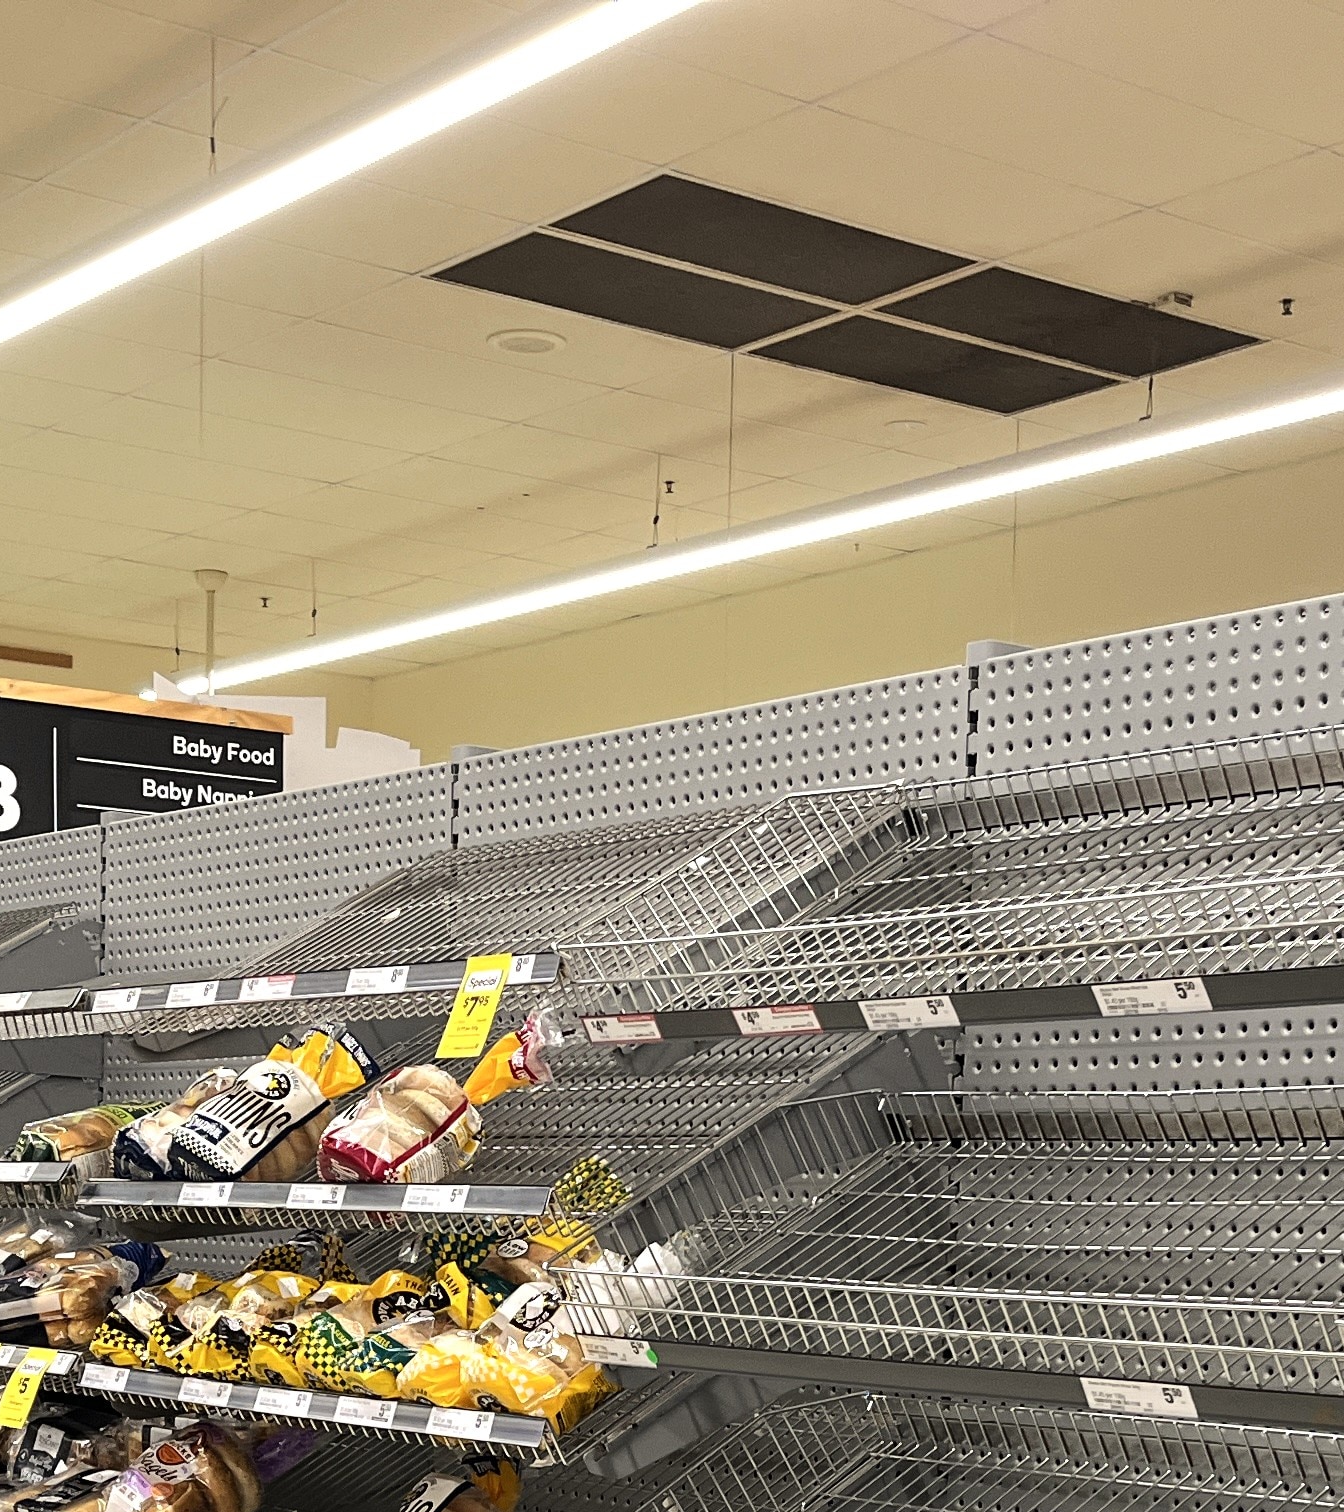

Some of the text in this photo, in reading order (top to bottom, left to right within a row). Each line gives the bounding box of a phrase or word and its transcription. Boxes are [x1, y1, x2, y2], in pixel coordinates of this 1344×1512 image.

[172, 735, 275, 766] Baby Food
[142, 777, 193, 806] Baby
